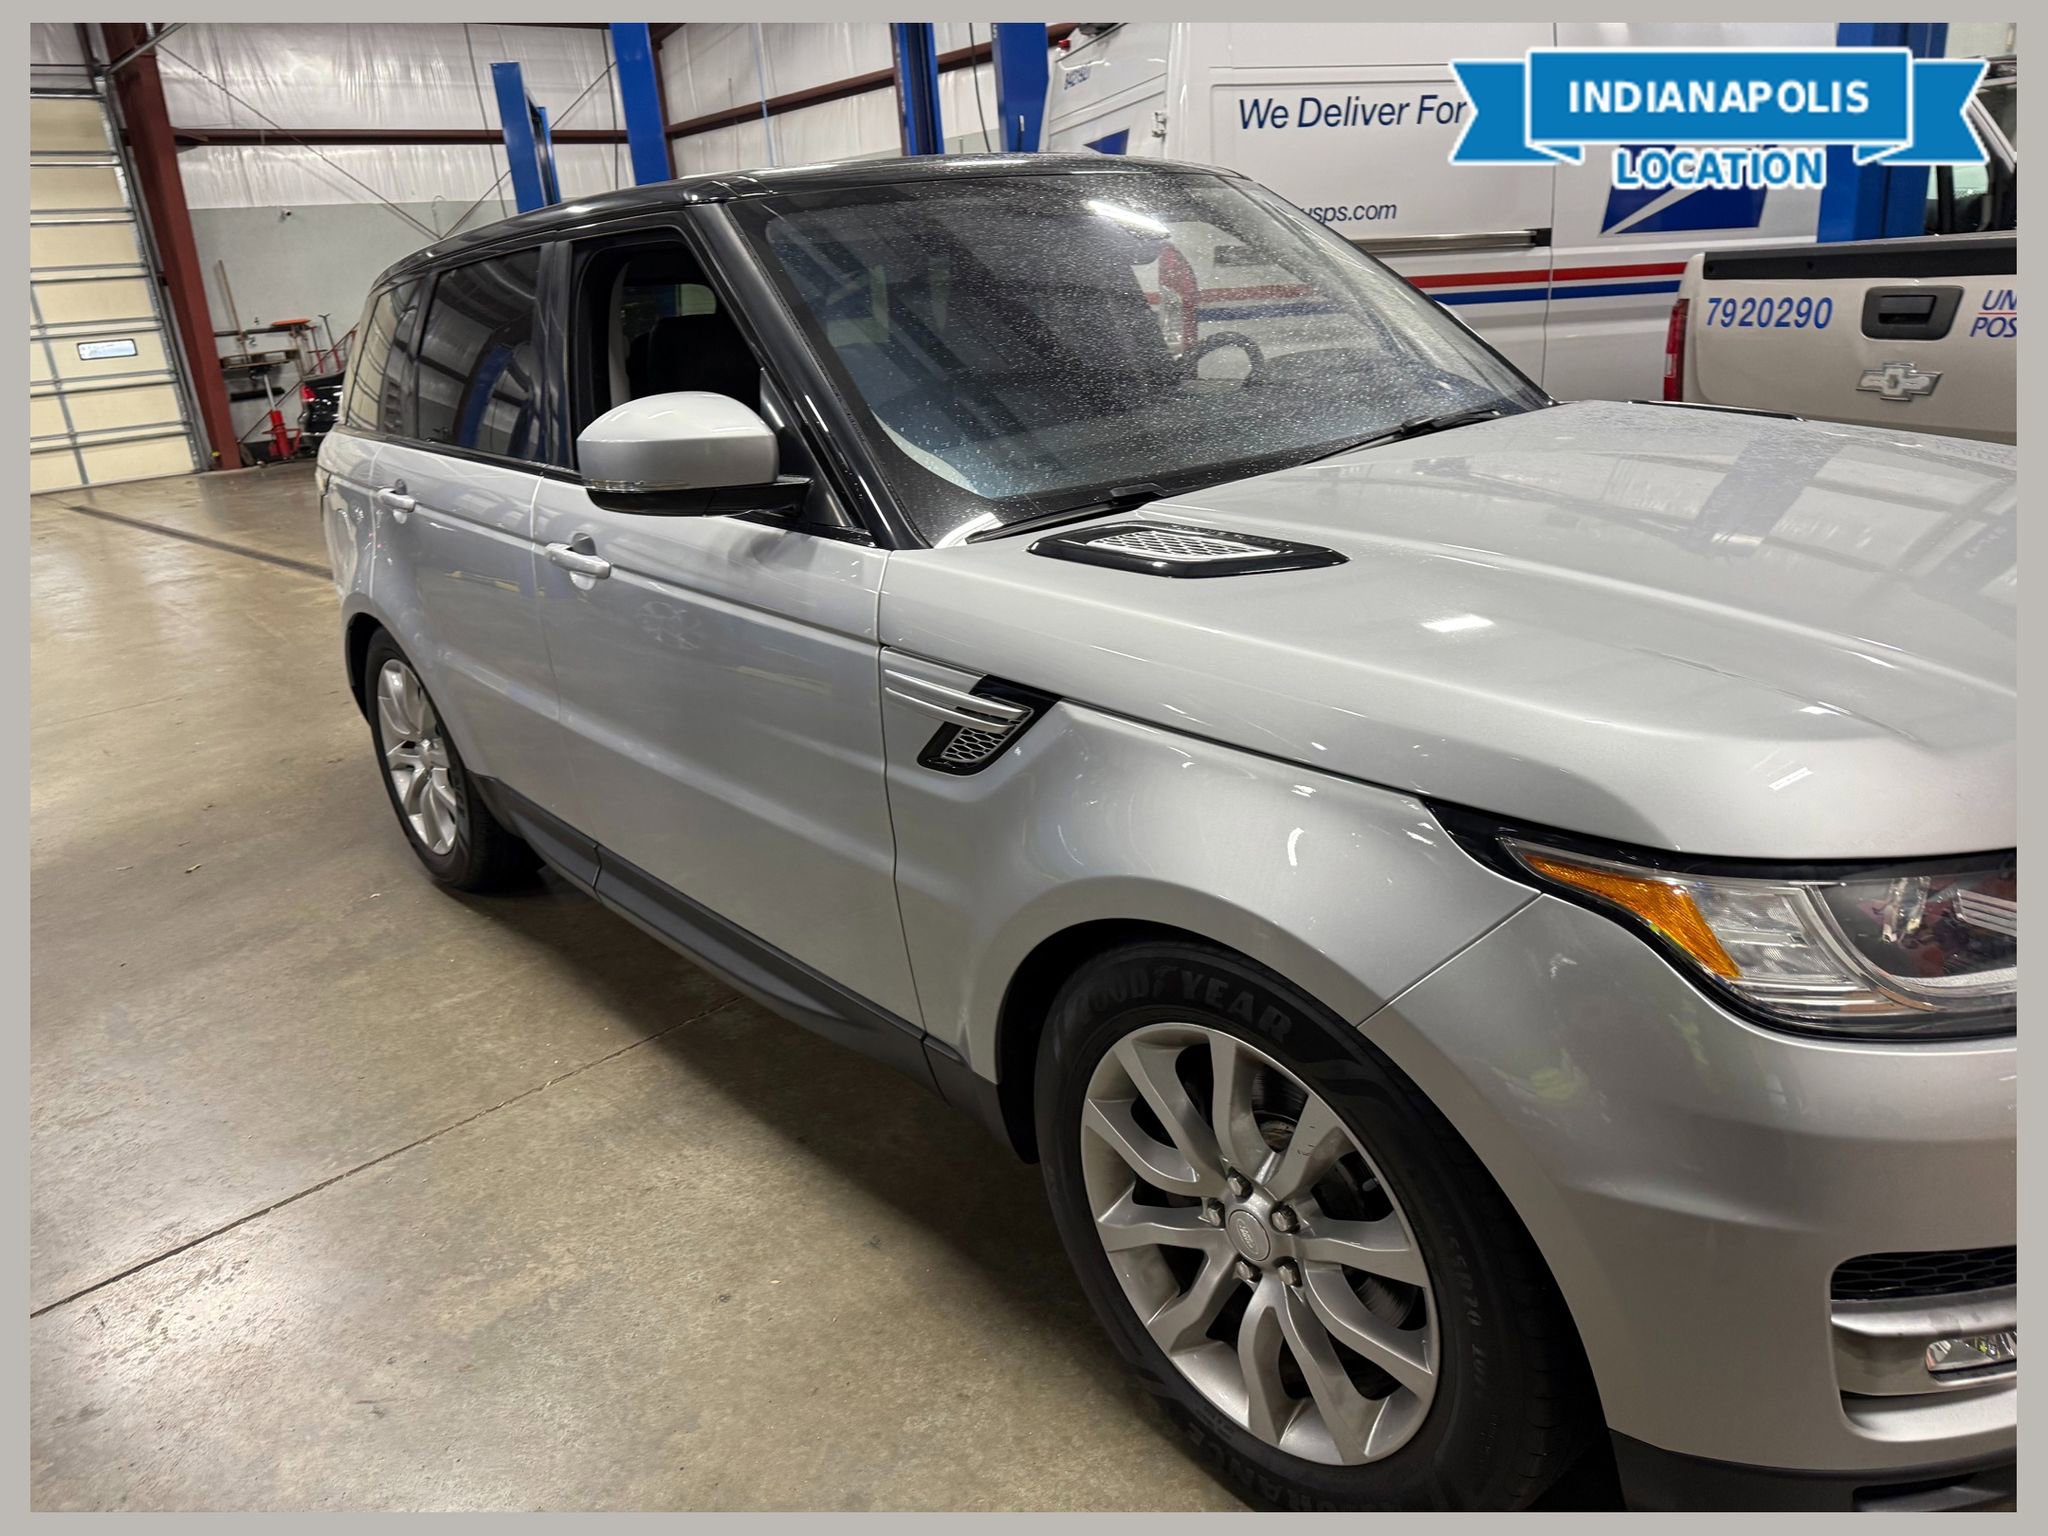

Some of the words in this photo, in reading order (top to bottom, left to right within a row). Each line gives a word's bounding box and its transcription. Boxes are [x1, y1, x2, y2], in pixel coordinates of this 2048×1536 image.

[1239, 98, 1289, 130] We
[1297, 94, 1409, 128] Deliver
[1417, 94, 1467, 125] For
[1705, 296, 1833, 329] 7920290
[1076, 966, 1292, 1043] OODYEAR
